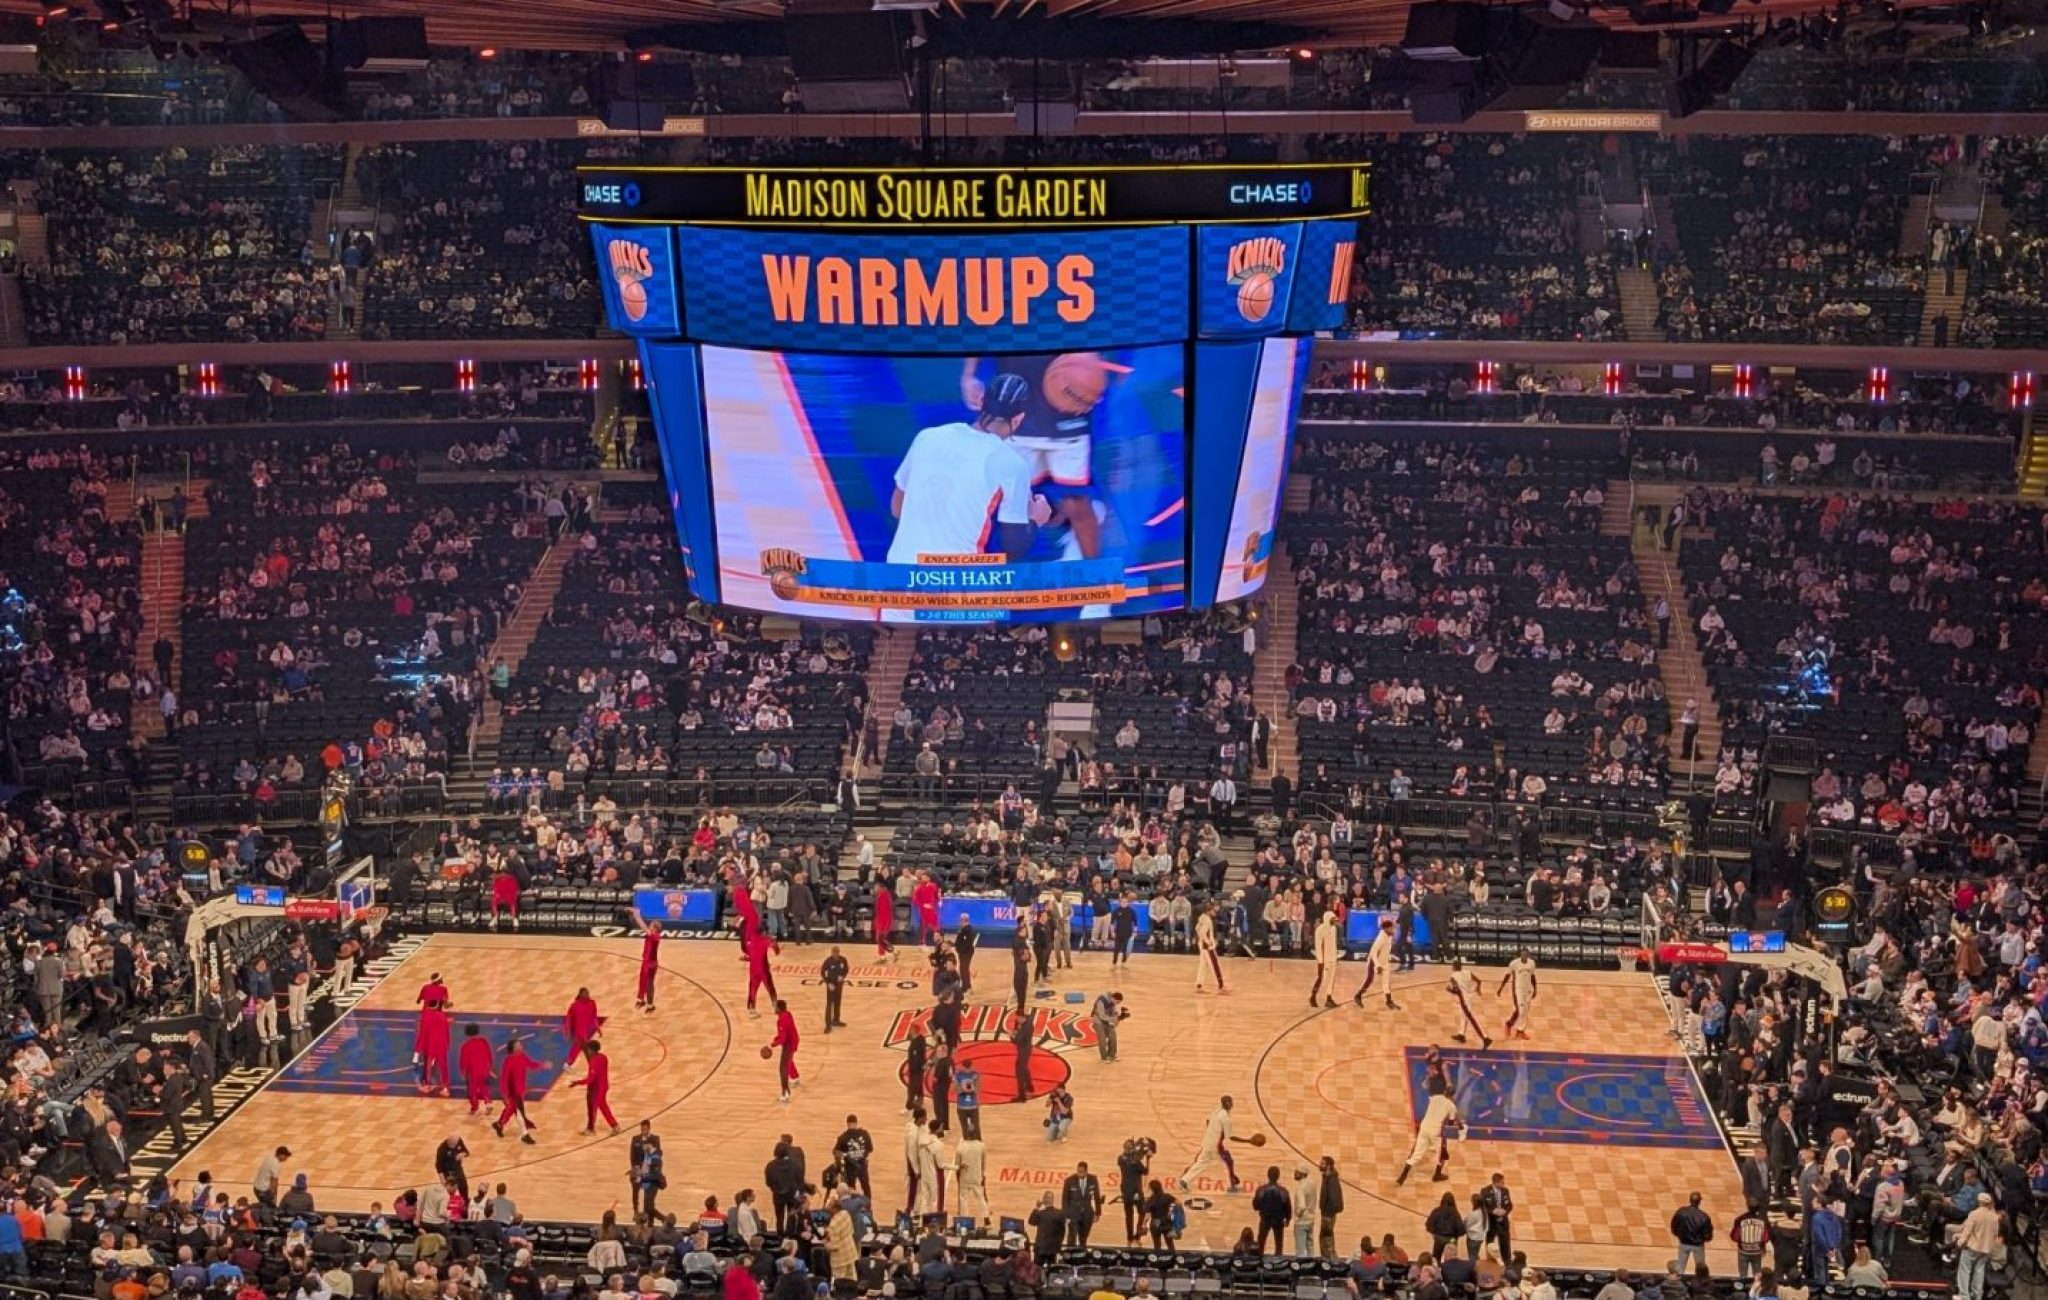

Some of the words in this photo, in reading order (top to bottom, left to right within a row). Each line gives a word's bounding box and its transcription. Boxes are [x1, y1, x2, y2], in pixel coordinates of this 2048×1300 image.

[666, 121, 704, 132] RIDGE
[1552, 117, 1611, 127] HYUNDAI
[1613, 116, 1660, 128] BRIDGE
[585, 185, 621, 203] CHASE
[746, 173, 867, 217] MADISON
[877, 173, 985, 221] SQUARE
[997, 173, 1106, 217] GARDEN
[1231, 183, 1298, 204] CHASE
[1228, 237, 1286, 283] KNICKS
[762, 254, 1095, 325] WARMUPS
[761, 549, 807, 575] KNICKS
[962, 554, 1000, 563] CAREER
[907, 570, 955, 588] JOSH
[961, 570, 1016, 586] HART
[628, 930, 740, 939] FNDUEL
[850, 967, 900, 977] QUARE
[1805, 999, 1816, 1034] ectrum
[1833, 1092, 1872, 1104] ectrum
[1000, 1168, 1066, 1184] MADIS
